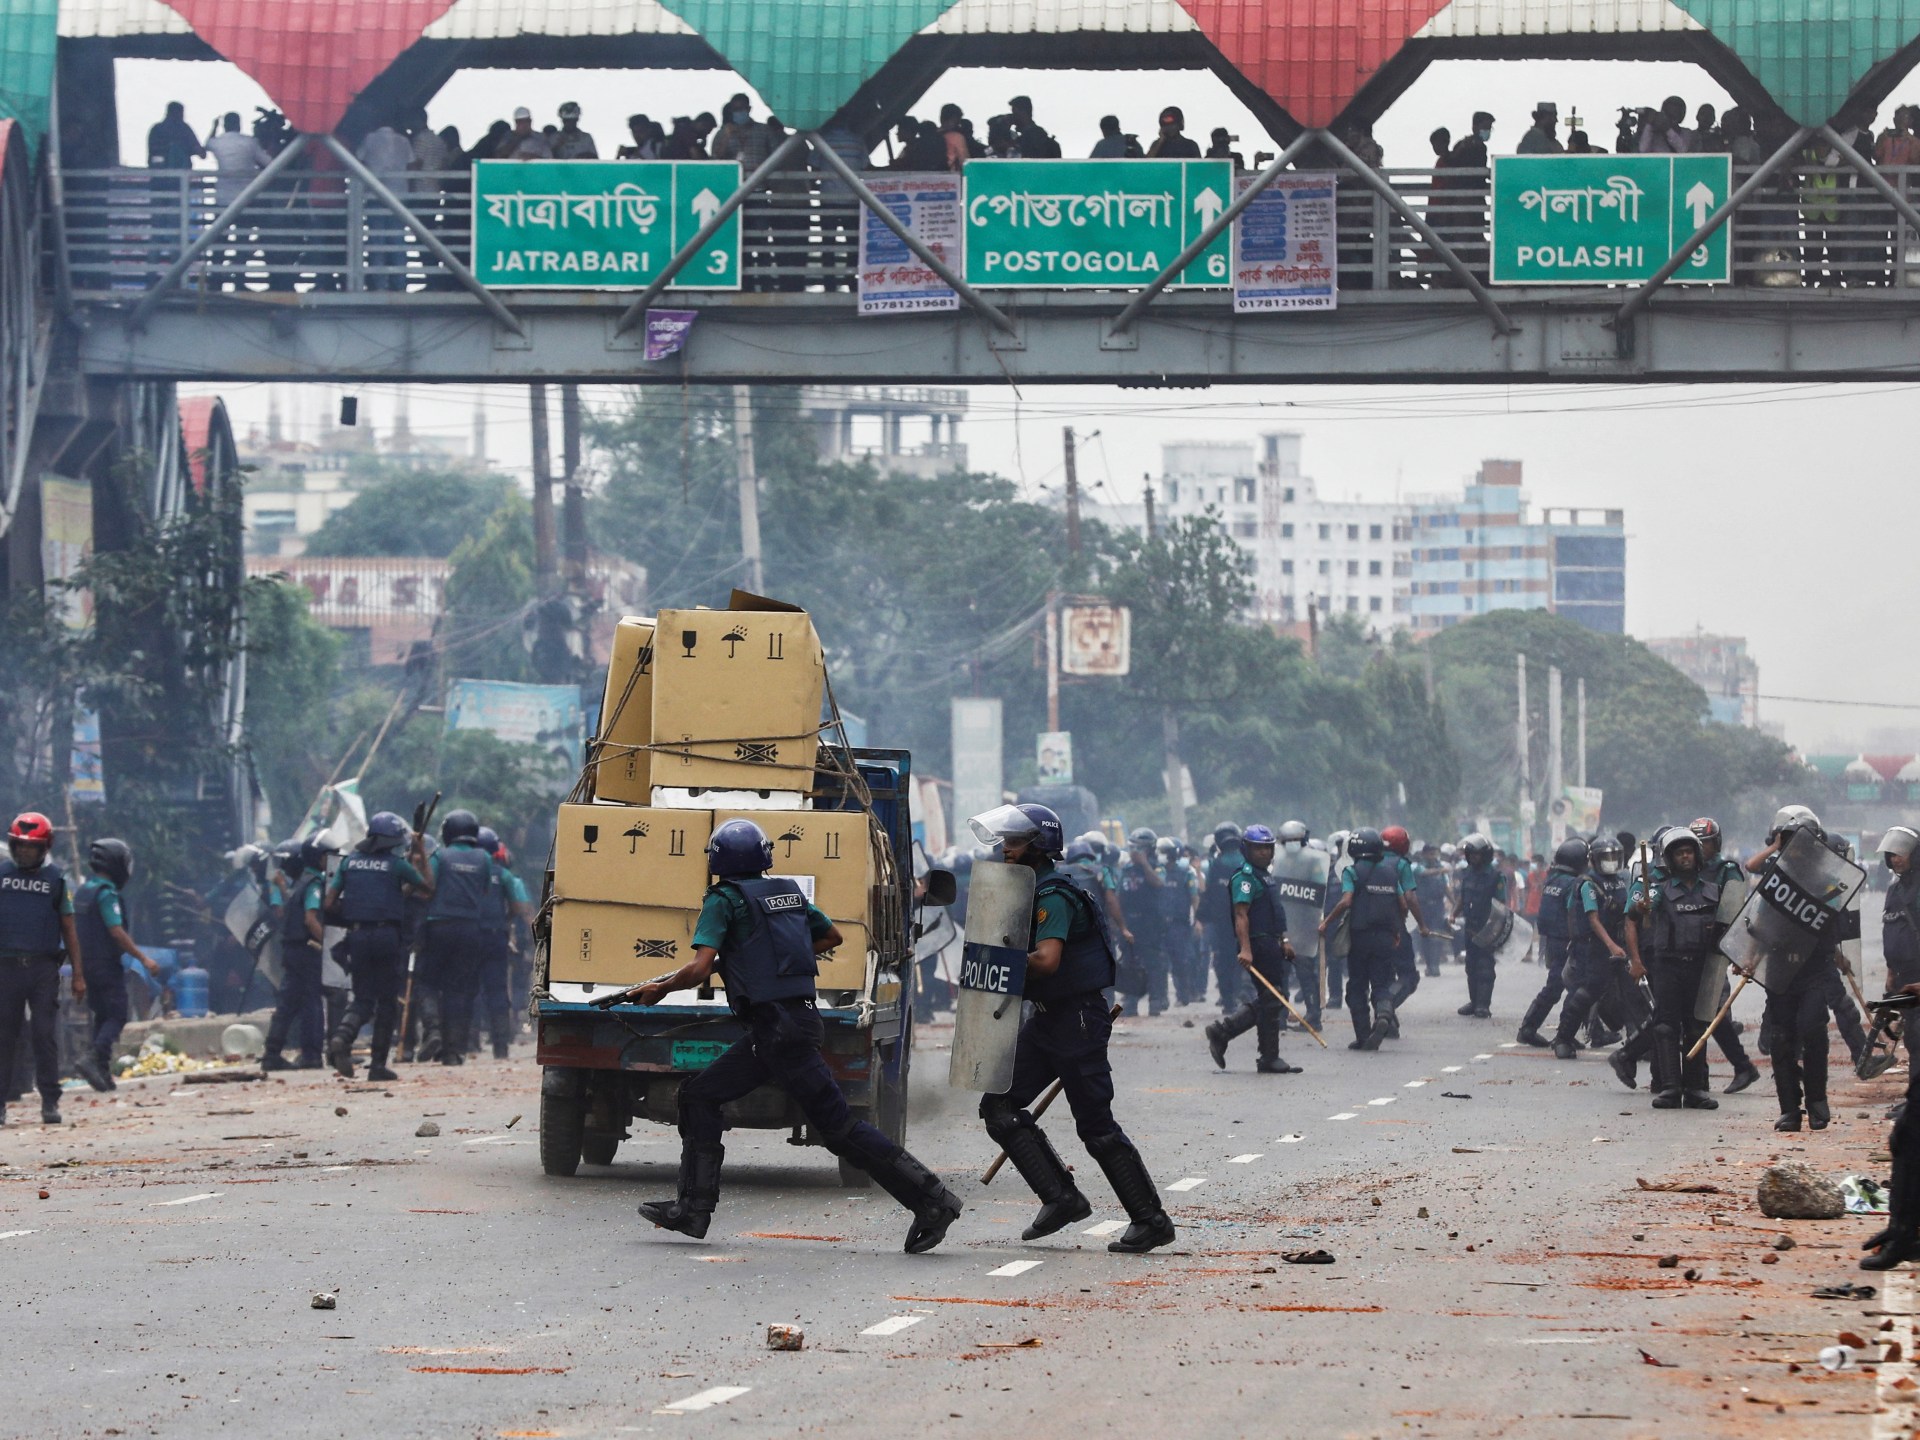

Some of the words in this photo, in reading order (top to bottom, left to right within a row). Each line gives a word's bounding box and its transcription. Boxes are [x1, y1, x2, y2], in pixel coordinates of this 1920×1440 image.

[482, 182, 660, 234] যাত্রাবাড়ি
[969, 190, 1175, 228] পোস্তগোলা
[1518, 175, 1645, 223] পলাশী
[491, 251, 649, 272] JATRABARI
[706, 250, 728, 274] 3
[984, 251, 1160, 272] POSTOGOLA
[1207, 254, 1226, 277] 6
[1517, 246, 1643, 267] POLASHI
[1691, 244, 1708, 267] 9
[863, 267, 886, 287] পার্ক
[1238, 264, 1262, 284] পার্ক
[1266, 264, 1332, 284] পলিটেকনিক
[864, 299, 955, 311] 01781219681
[1239, 298, 1331, 308] 01781219681
[1041, 820, 1059, 829] POLICE
[348, 860, 390, 871] POLICE
[2, 878, 51, 893] POLICE
[1281, 883, 1316, 900] POLICE
[770, 895, 799, 908] POLICE
[1764, 873, 1829, 930] POLICE
[964, 960, 1011, 993] POLICE
